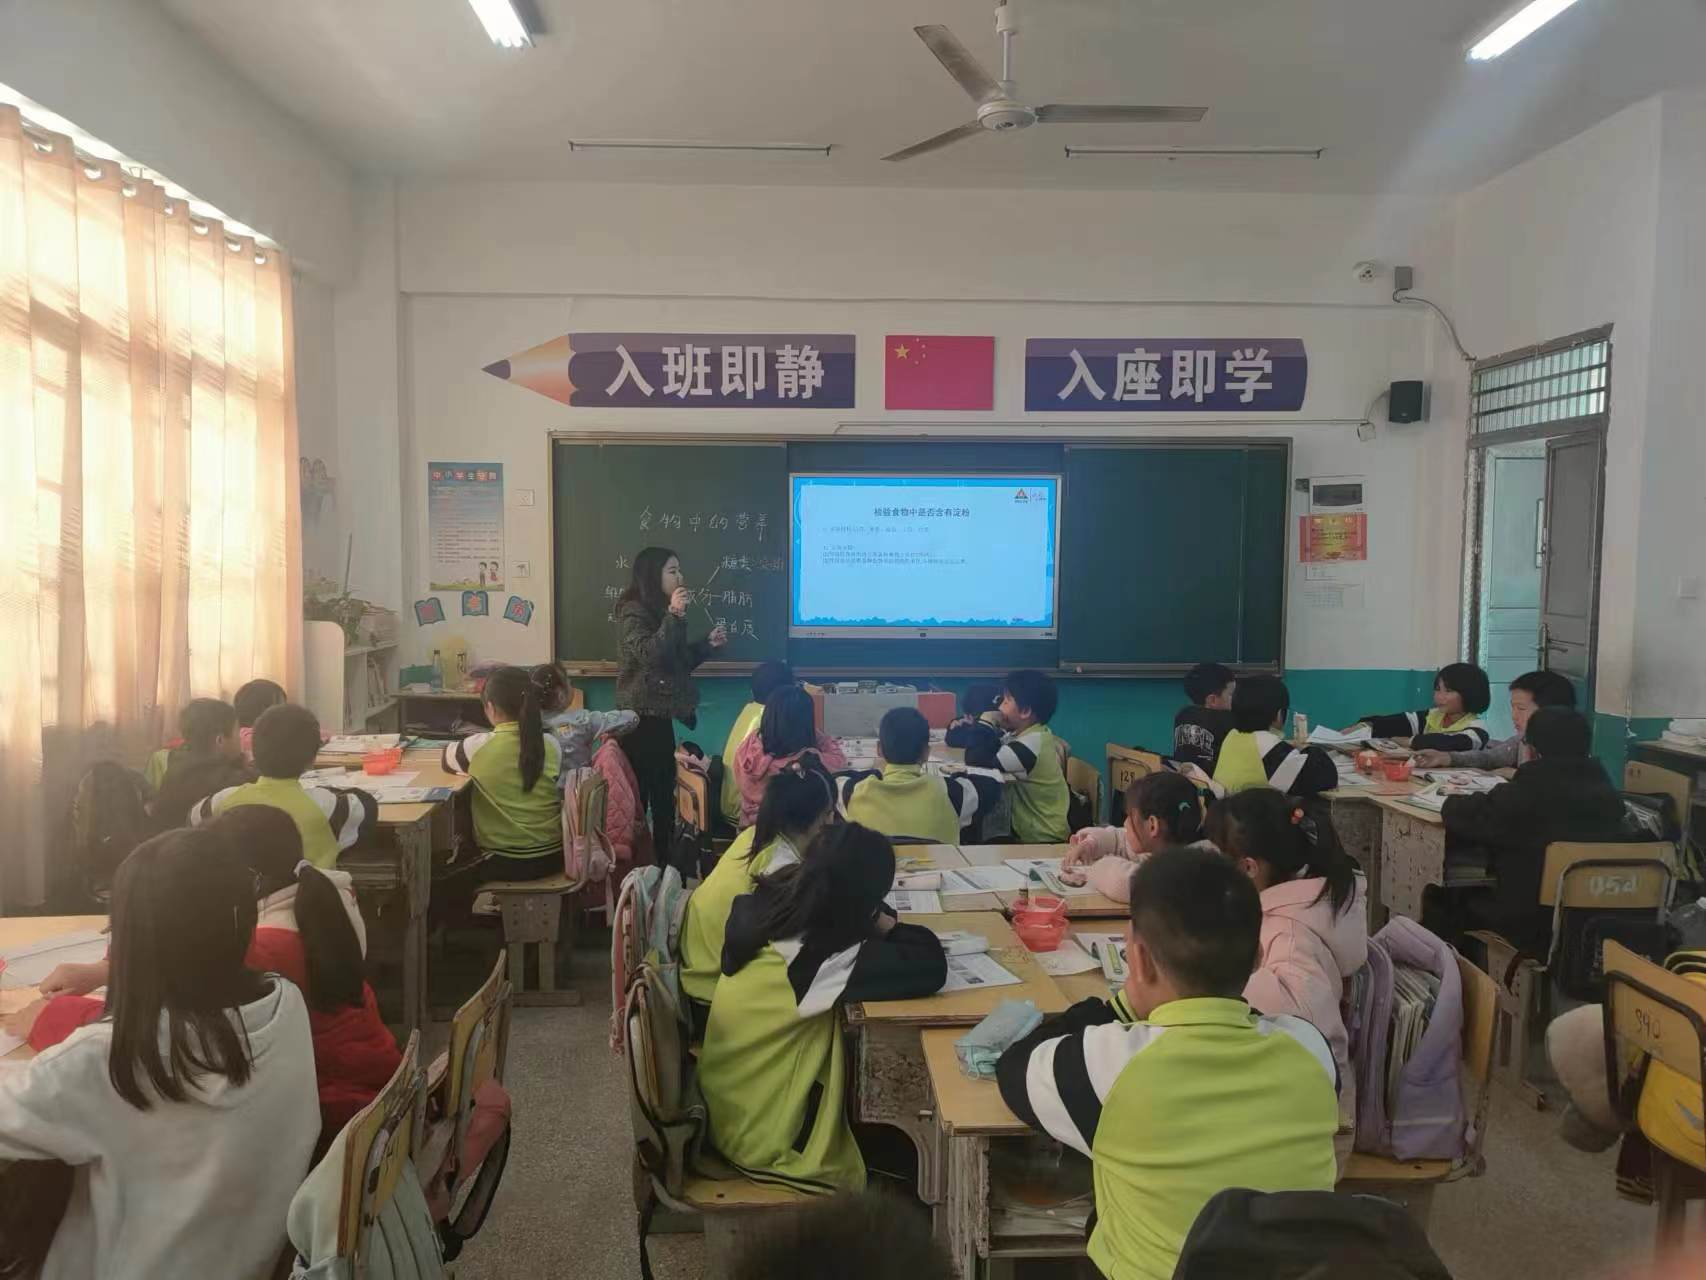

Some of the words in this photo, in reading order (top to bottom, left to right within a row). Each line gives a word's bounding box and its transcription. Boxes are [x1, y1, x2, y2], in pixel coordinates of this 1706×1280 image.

[605, 344, 825, 400] 入班即静
[1057, 348, 1273, 403] 入座即学
[639, 504, 768, 541] 食物中的营养
[873, 507, 970, 518] 检验食物中是否含有淀粉
[616, 555, 631, 568] 水
